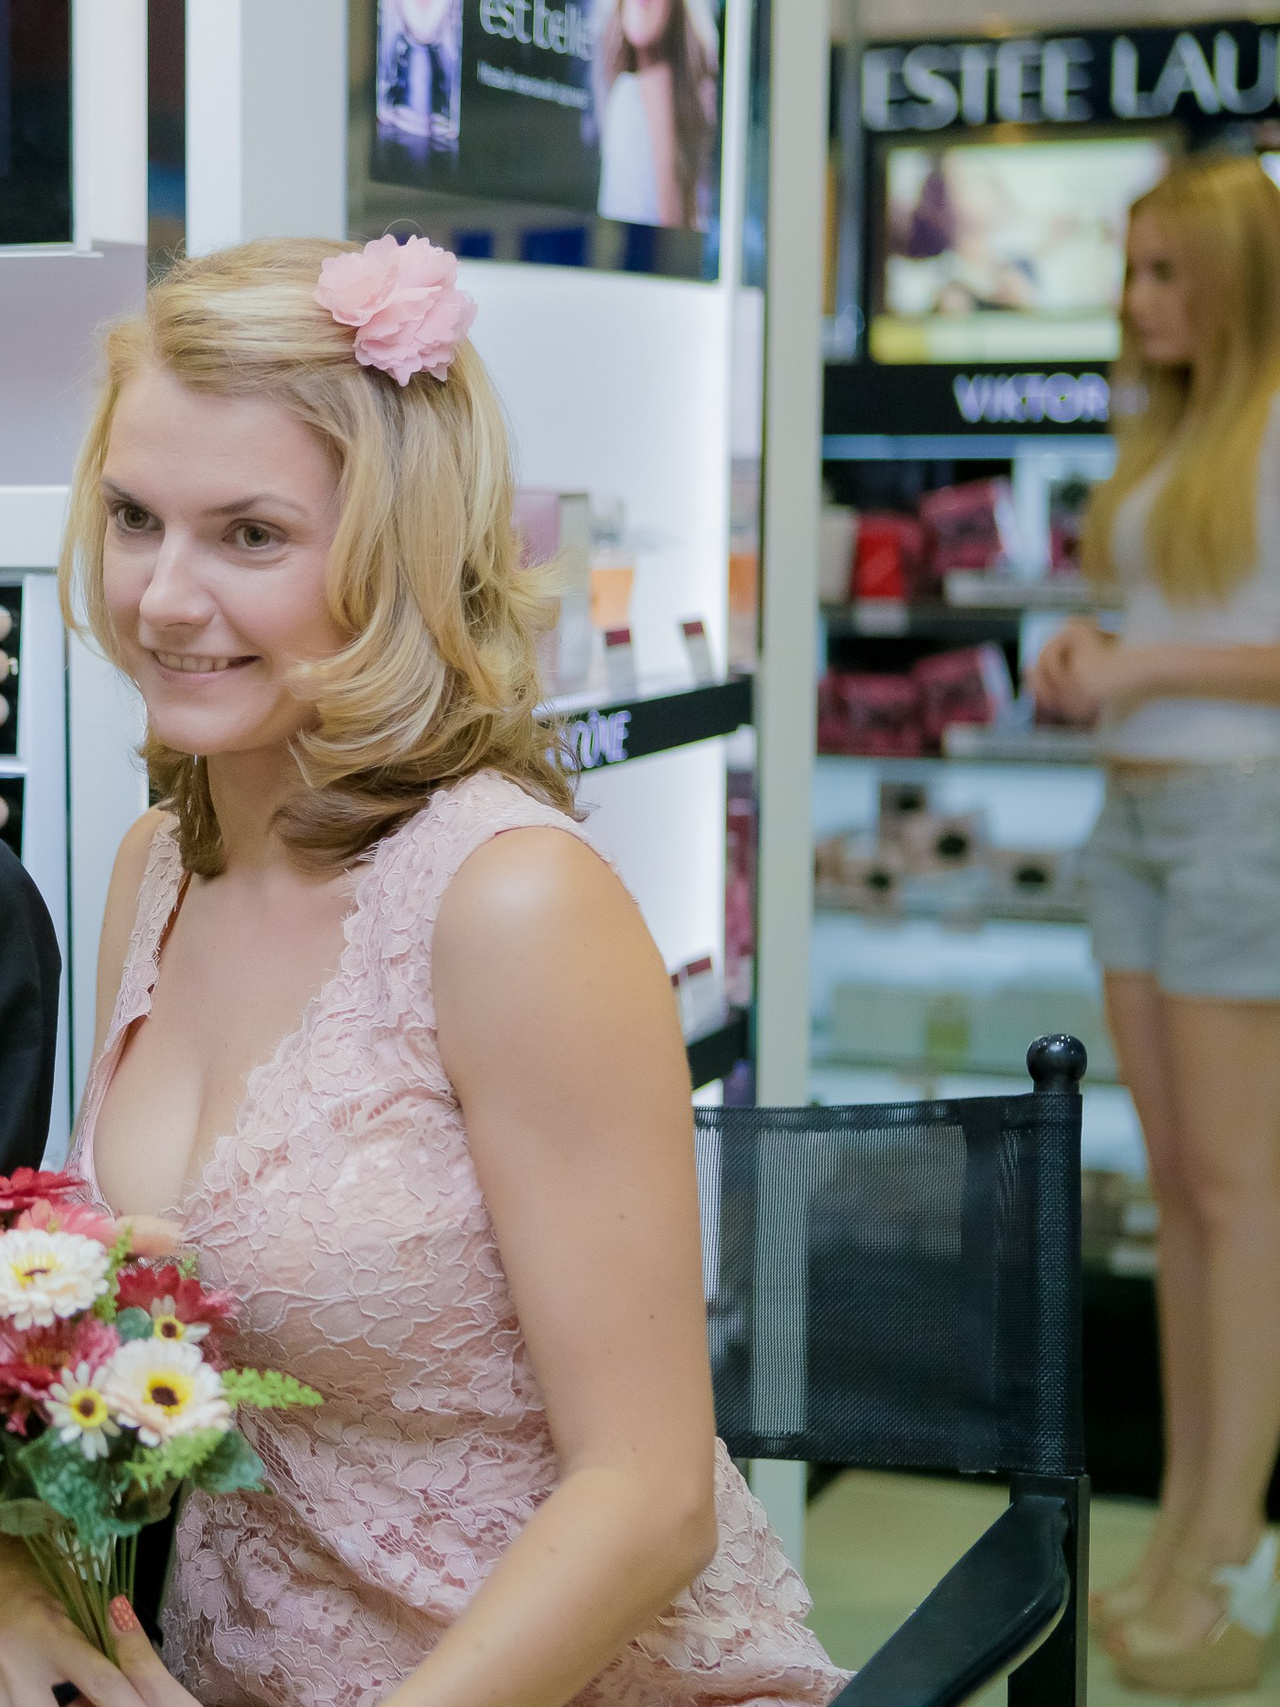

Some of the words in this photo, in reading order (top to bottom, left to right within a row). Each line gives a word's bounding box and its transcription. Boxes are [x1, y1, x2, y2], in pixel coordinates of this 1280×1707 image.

[862, 39, 1095, 131] ESTEE
[1111, 30, 1280, 118] LAU
[953, 372, 1114, 423] VIKTOR
